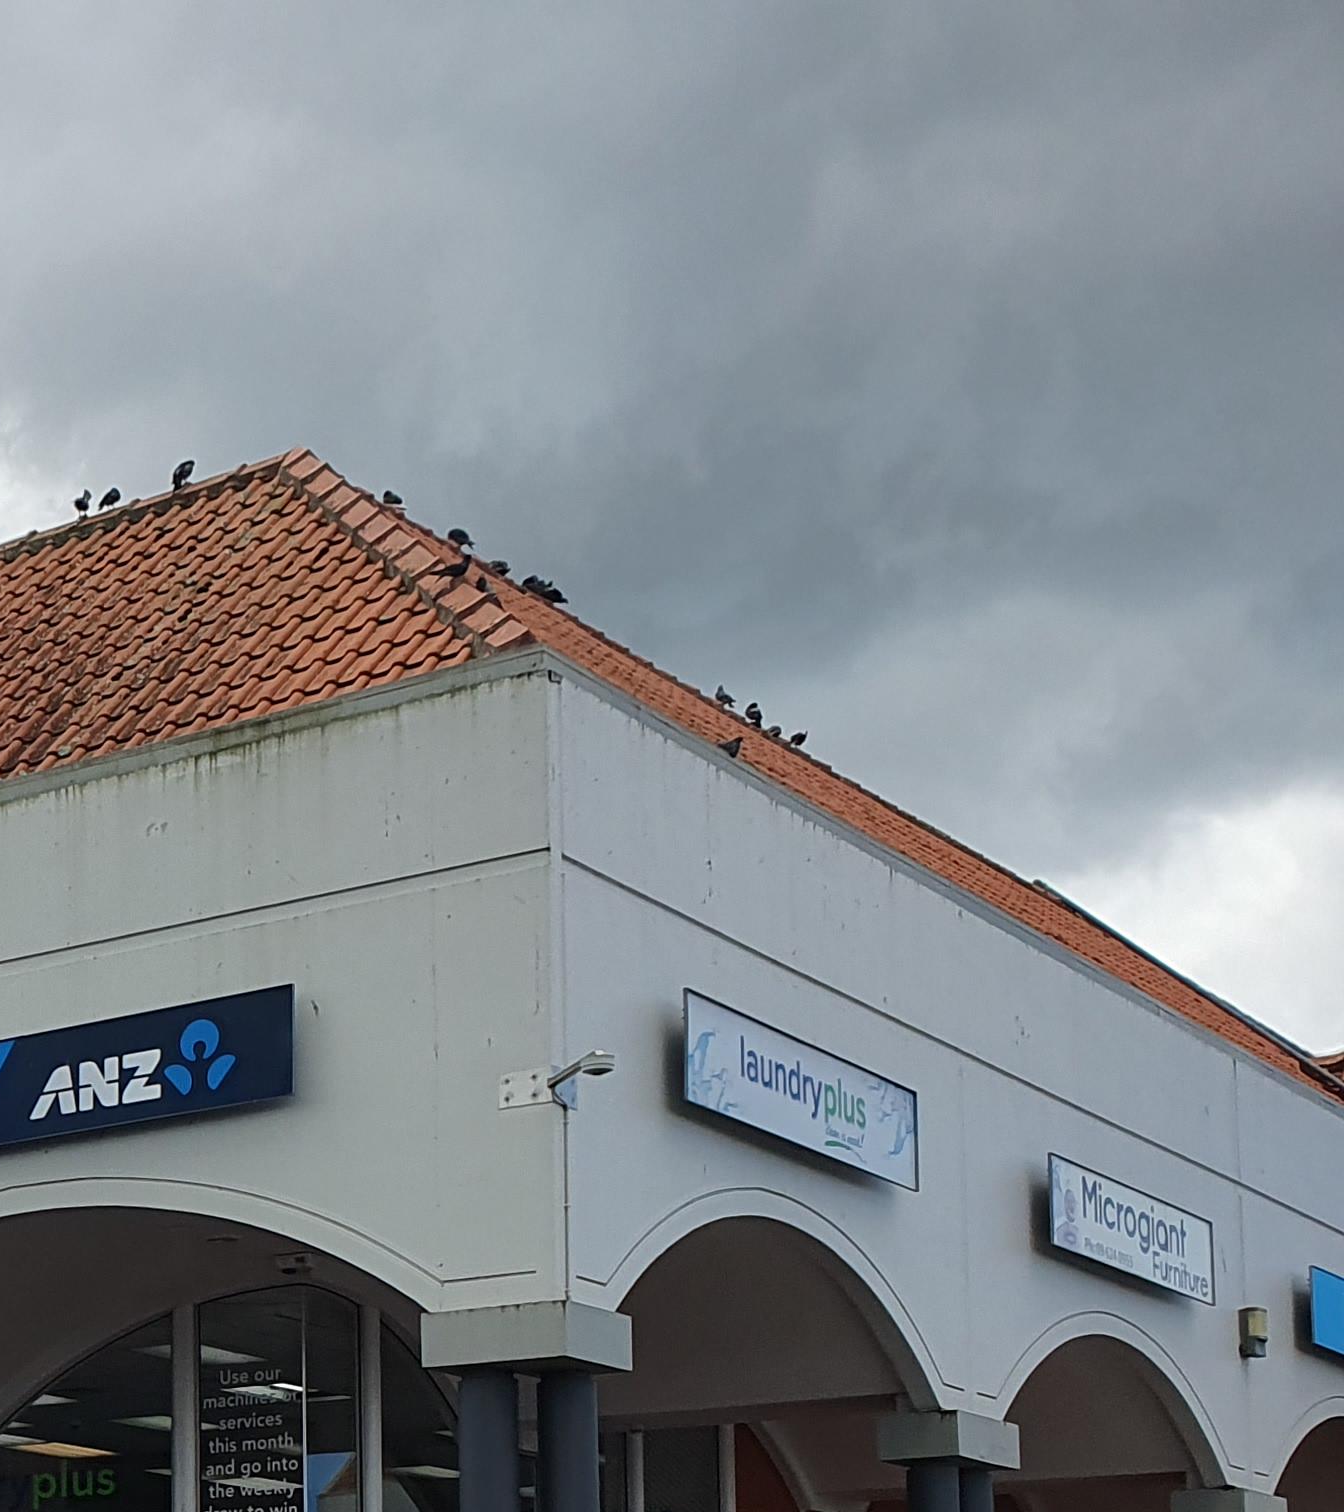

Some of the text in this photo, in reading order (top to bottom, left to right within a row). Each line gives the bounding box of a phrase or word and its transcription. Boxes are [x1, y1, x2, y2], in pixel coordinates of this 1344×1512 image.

[29, 1048, 162, 1121] ANZ
[740, 1035, 867, 1130] laundryplus
[1082, 1176, 1187, 1258] Microgiant
[1152, 1250, 1209, 1297] Furniture
[220, 1368, 281, 1385] Use our
[219, 1412, 282, 1430] services
[209, 1432, 294, 1454] this month
[206, 1457, 298, 1478] and go into
[209, 1482, 235, 1499] the
